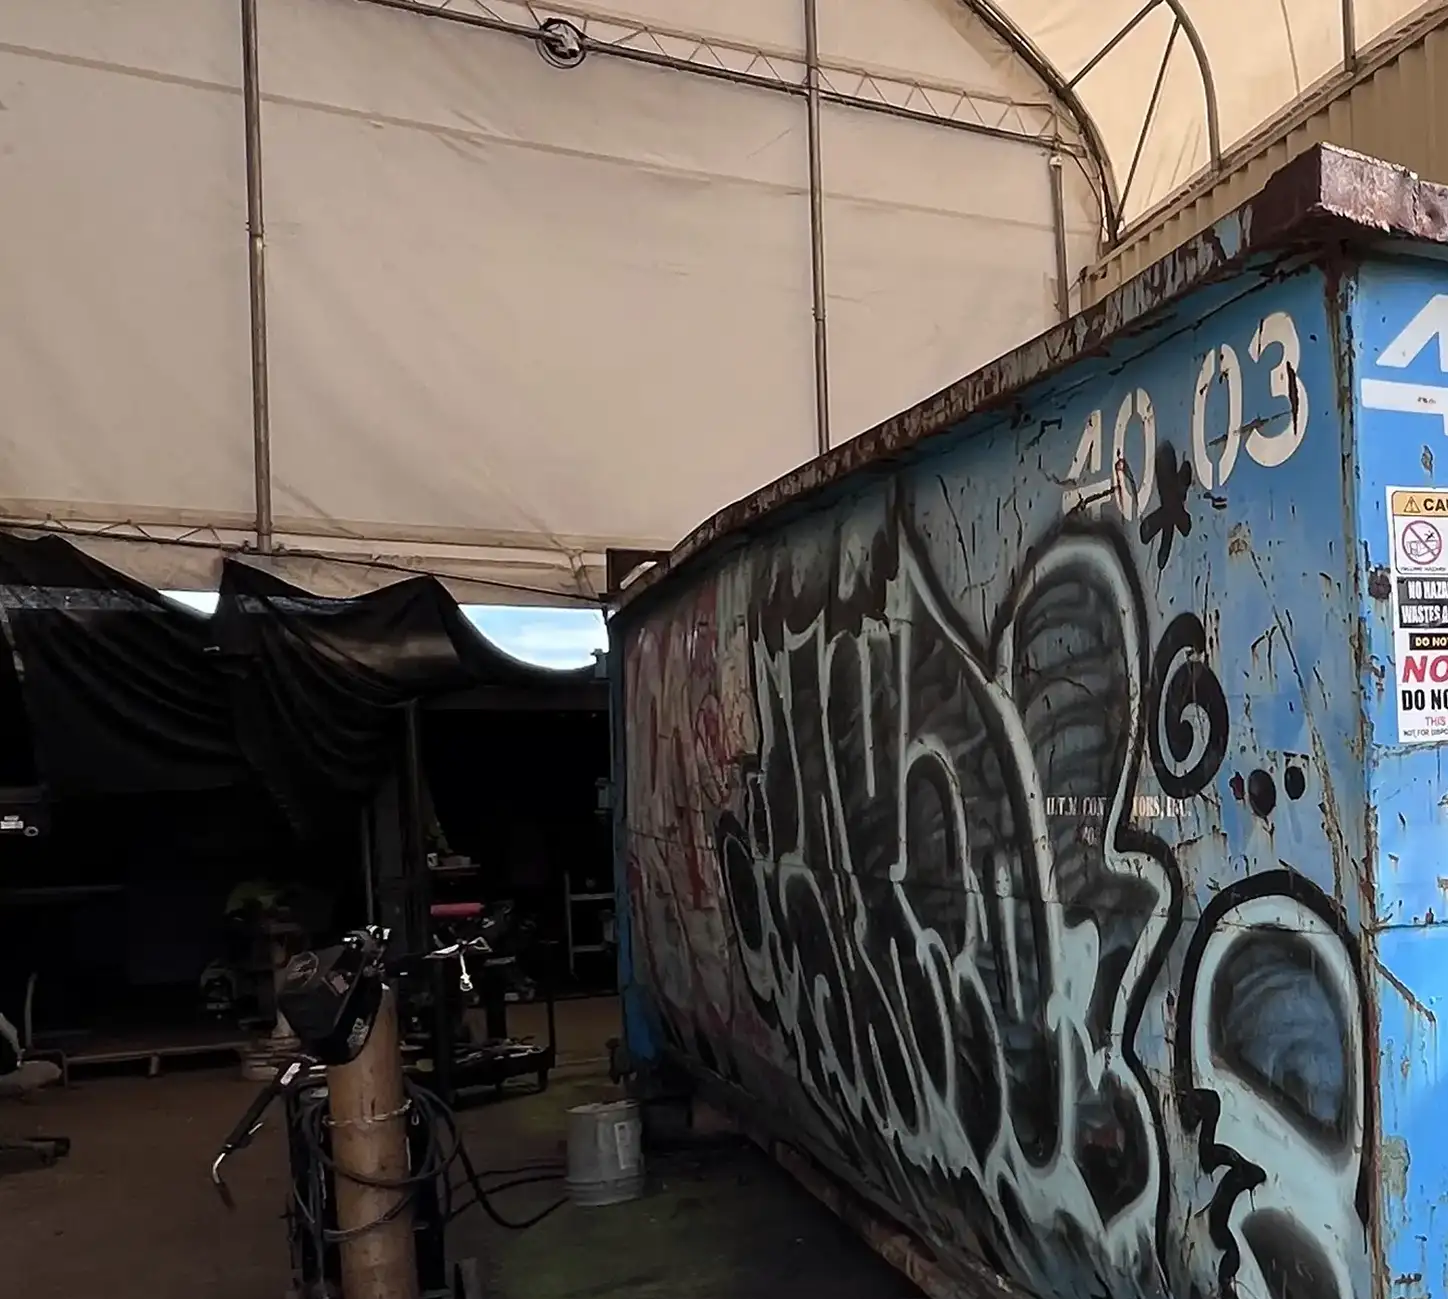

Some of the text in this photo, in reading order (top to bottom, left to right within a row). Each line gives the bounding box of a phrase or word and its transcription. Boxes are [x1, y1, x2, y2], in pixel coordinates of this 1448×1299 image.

[1192, 311, 1309, 491] 03
[1407, 580, 1422, 599] NO
[1401, 605, 1441, 624] WASTES
[1415, 636, 1430, 647] DO
[1401, 689, 1426, 711] DO
[1425, 716, 1446, 726] THIS
